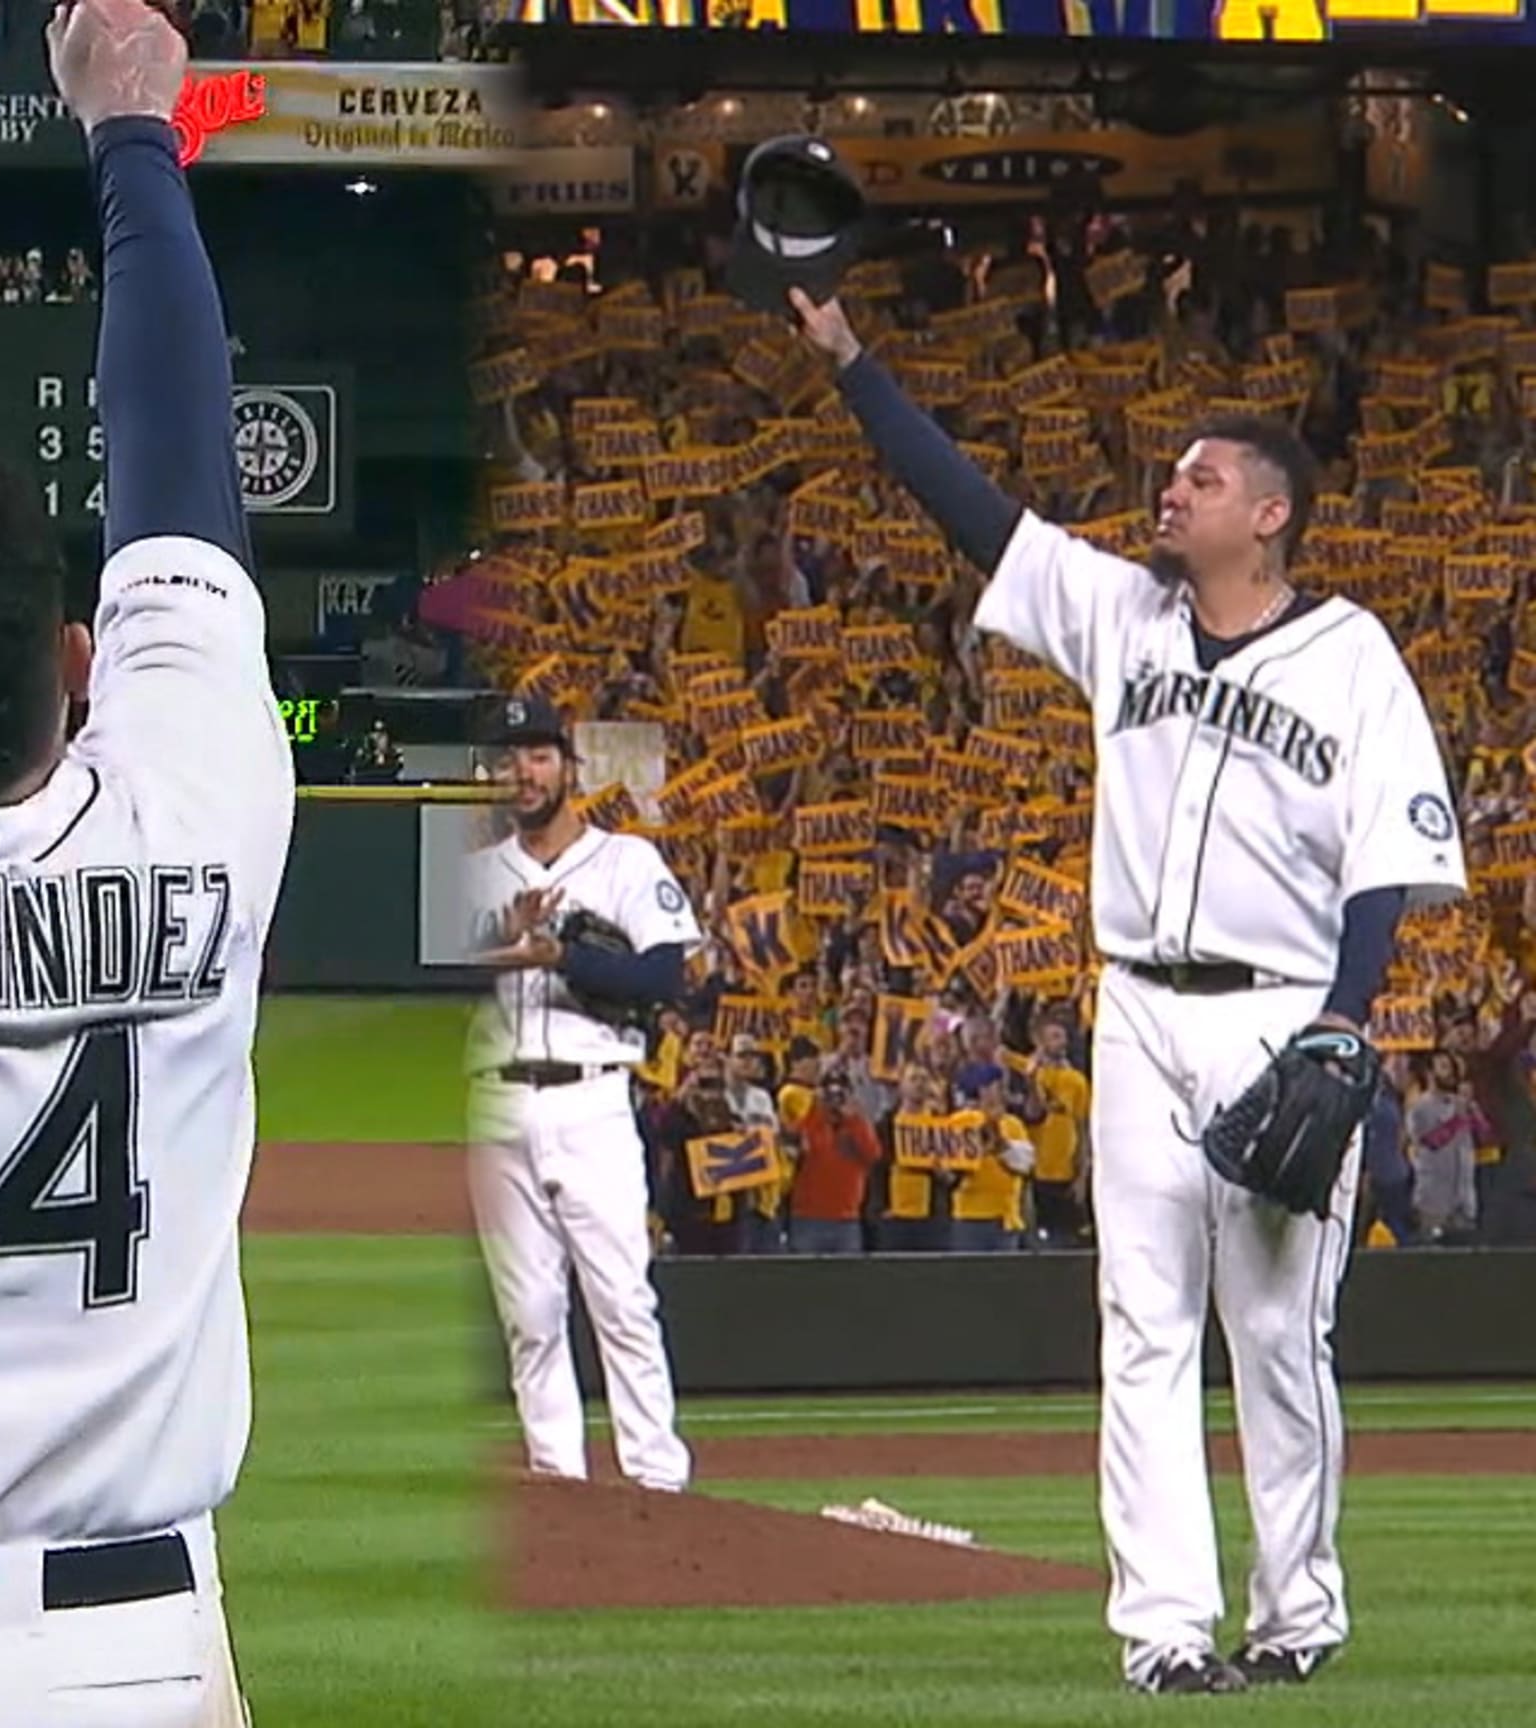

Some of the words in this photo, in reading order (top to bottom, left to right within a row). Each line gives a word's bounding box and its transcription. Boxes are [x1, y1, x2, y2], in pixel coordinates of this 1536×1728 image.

[338, 88, 482, 115] CERVEZA
[0, 119, 38, 142] BY
[304, 119, 402, 154] Original
[38, 378, 64, 407] R
[39, 426, 63, 461] 3
[43, 482, 59, 516] 1
[506, 701, 526, 726] S
[706, 1130, 770, 1184] K
